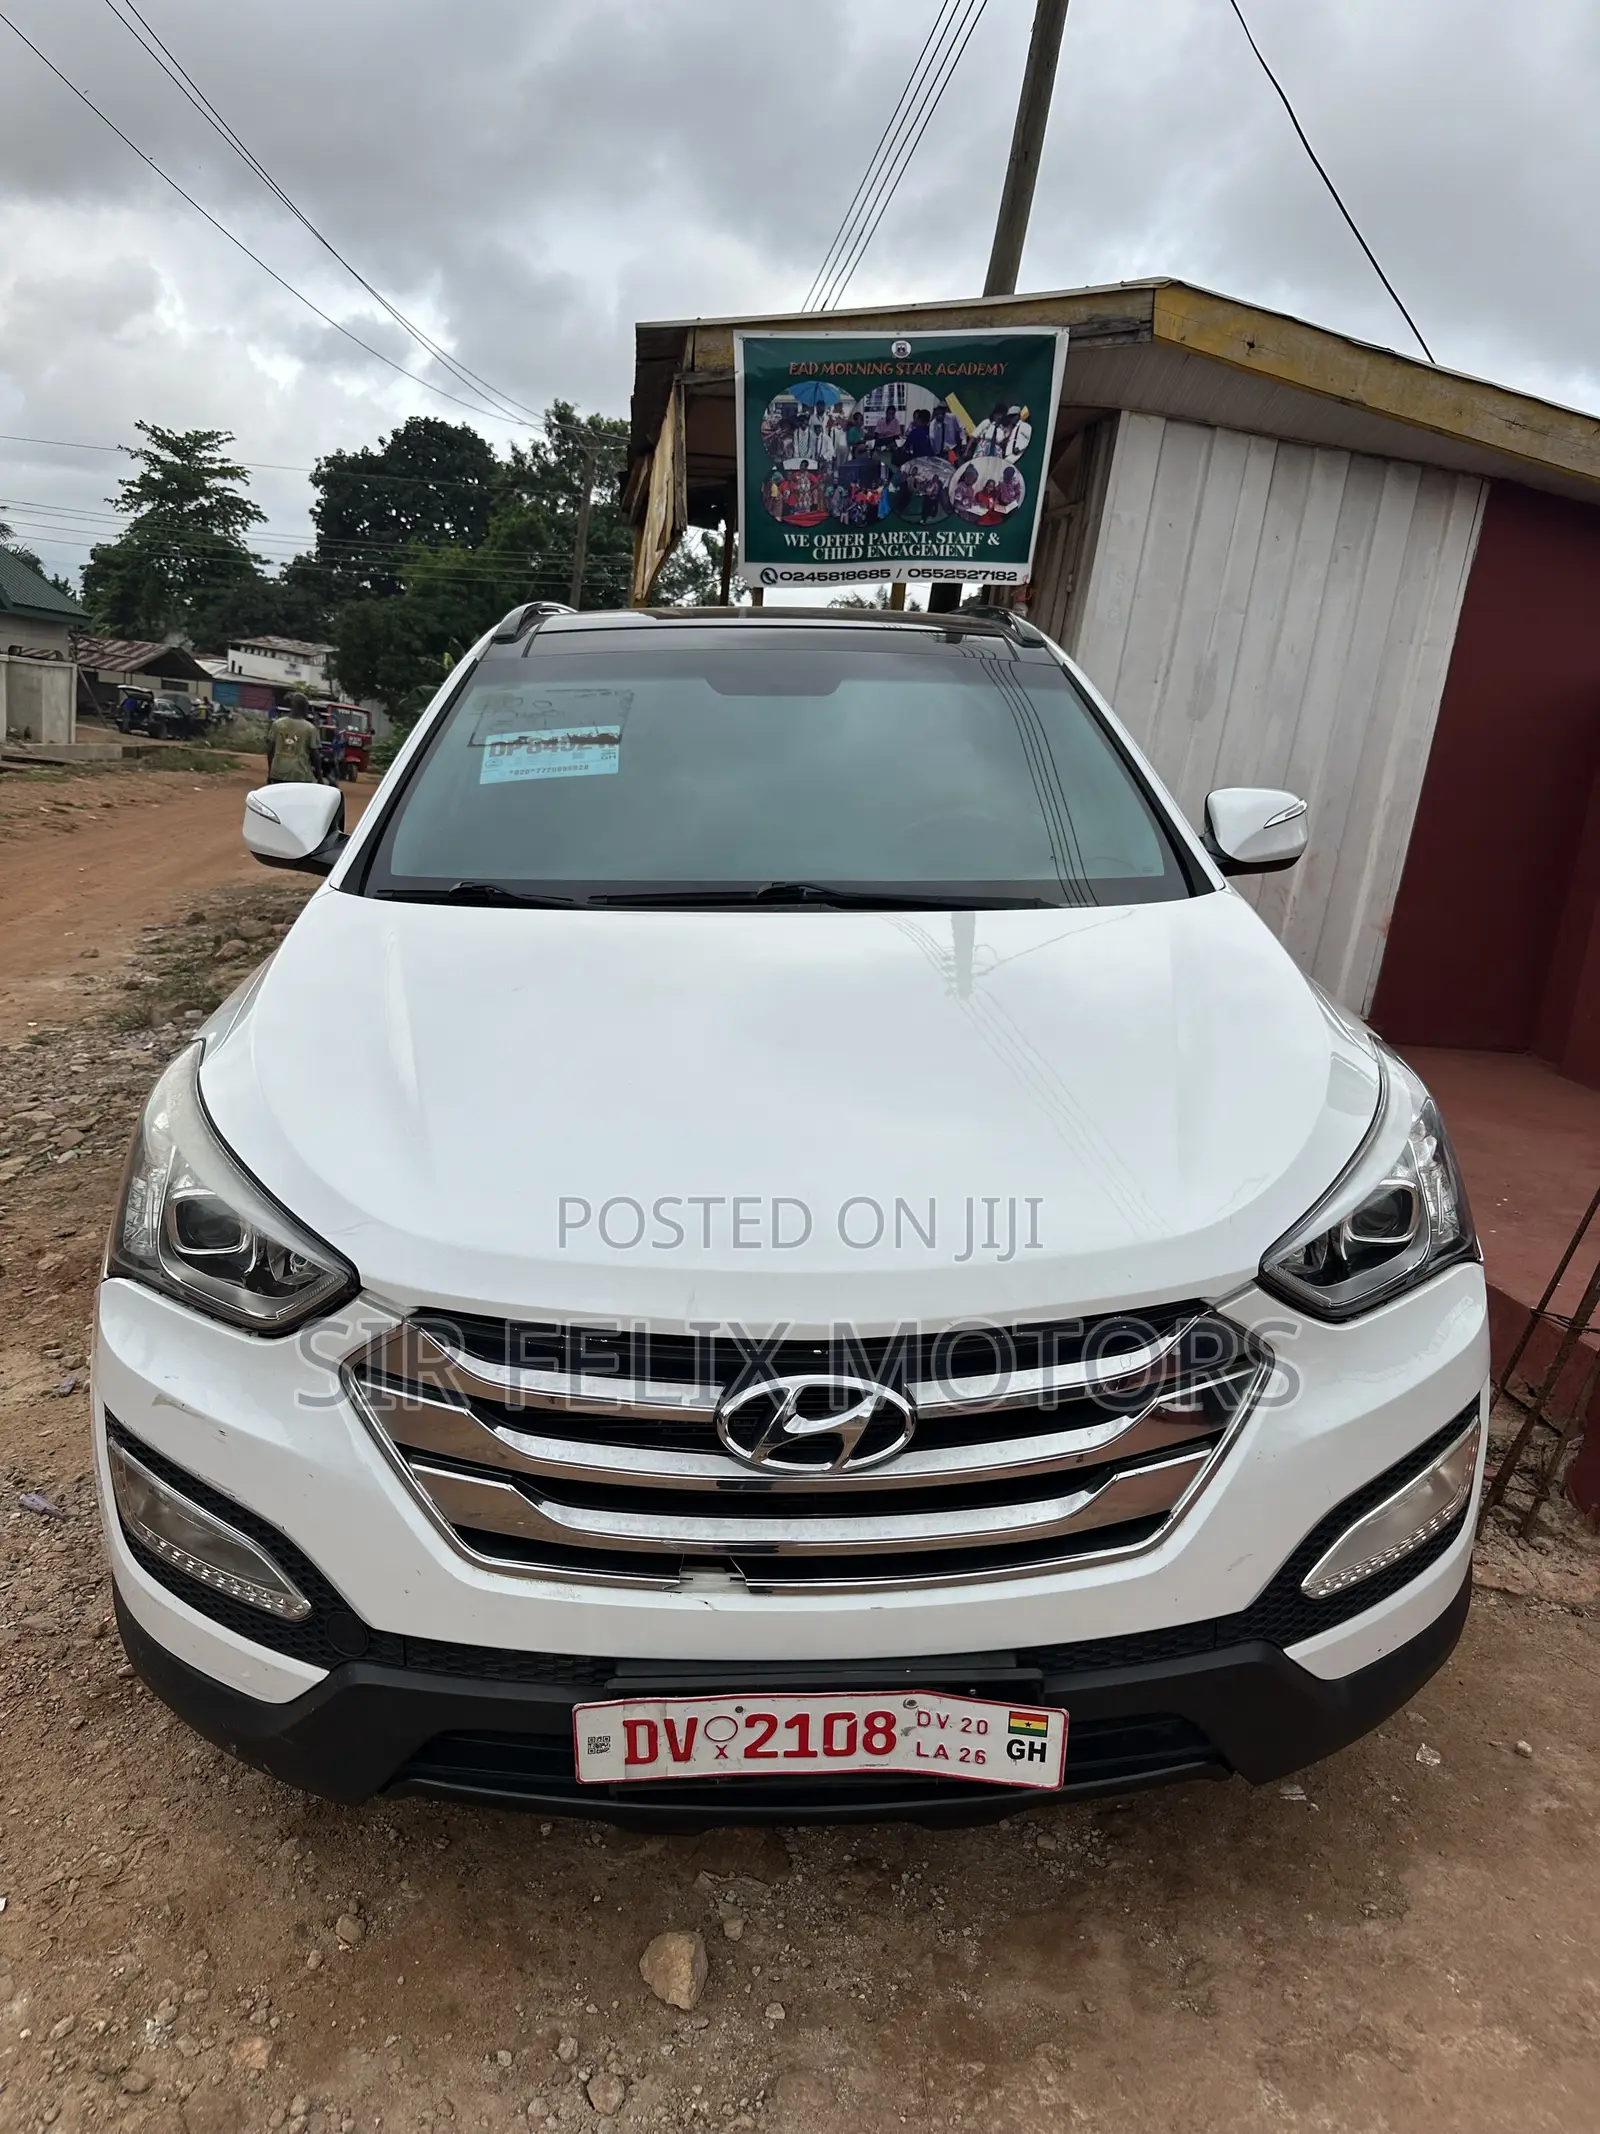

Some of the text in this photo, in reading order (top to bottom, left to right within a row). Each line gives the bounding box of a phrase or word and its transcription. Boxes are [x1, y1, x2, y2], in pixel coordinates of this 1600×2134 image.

[821, 361, 893, 376] MORNING
[896, 361, 932, 376] STAR
[935, 362, 1008, 376] ACADEMY
[784, 531, 1001, 548] WE OFFER PARENT, STAFF &
[812, 545, 977, 561] CHILD ENGAGEMENT
[779, 568, 891, 582] 0245818685
[907, 568, 1018, 582] 0552527182
[916, 1710, 989, 1735] DV 20
[622, 1716, 698, 1765] DV
[743, 1710, 897, 1759] 2108
[916, 1741, 987, 1765] LA 26
[1006, 1738, 1047, 1763] GH
